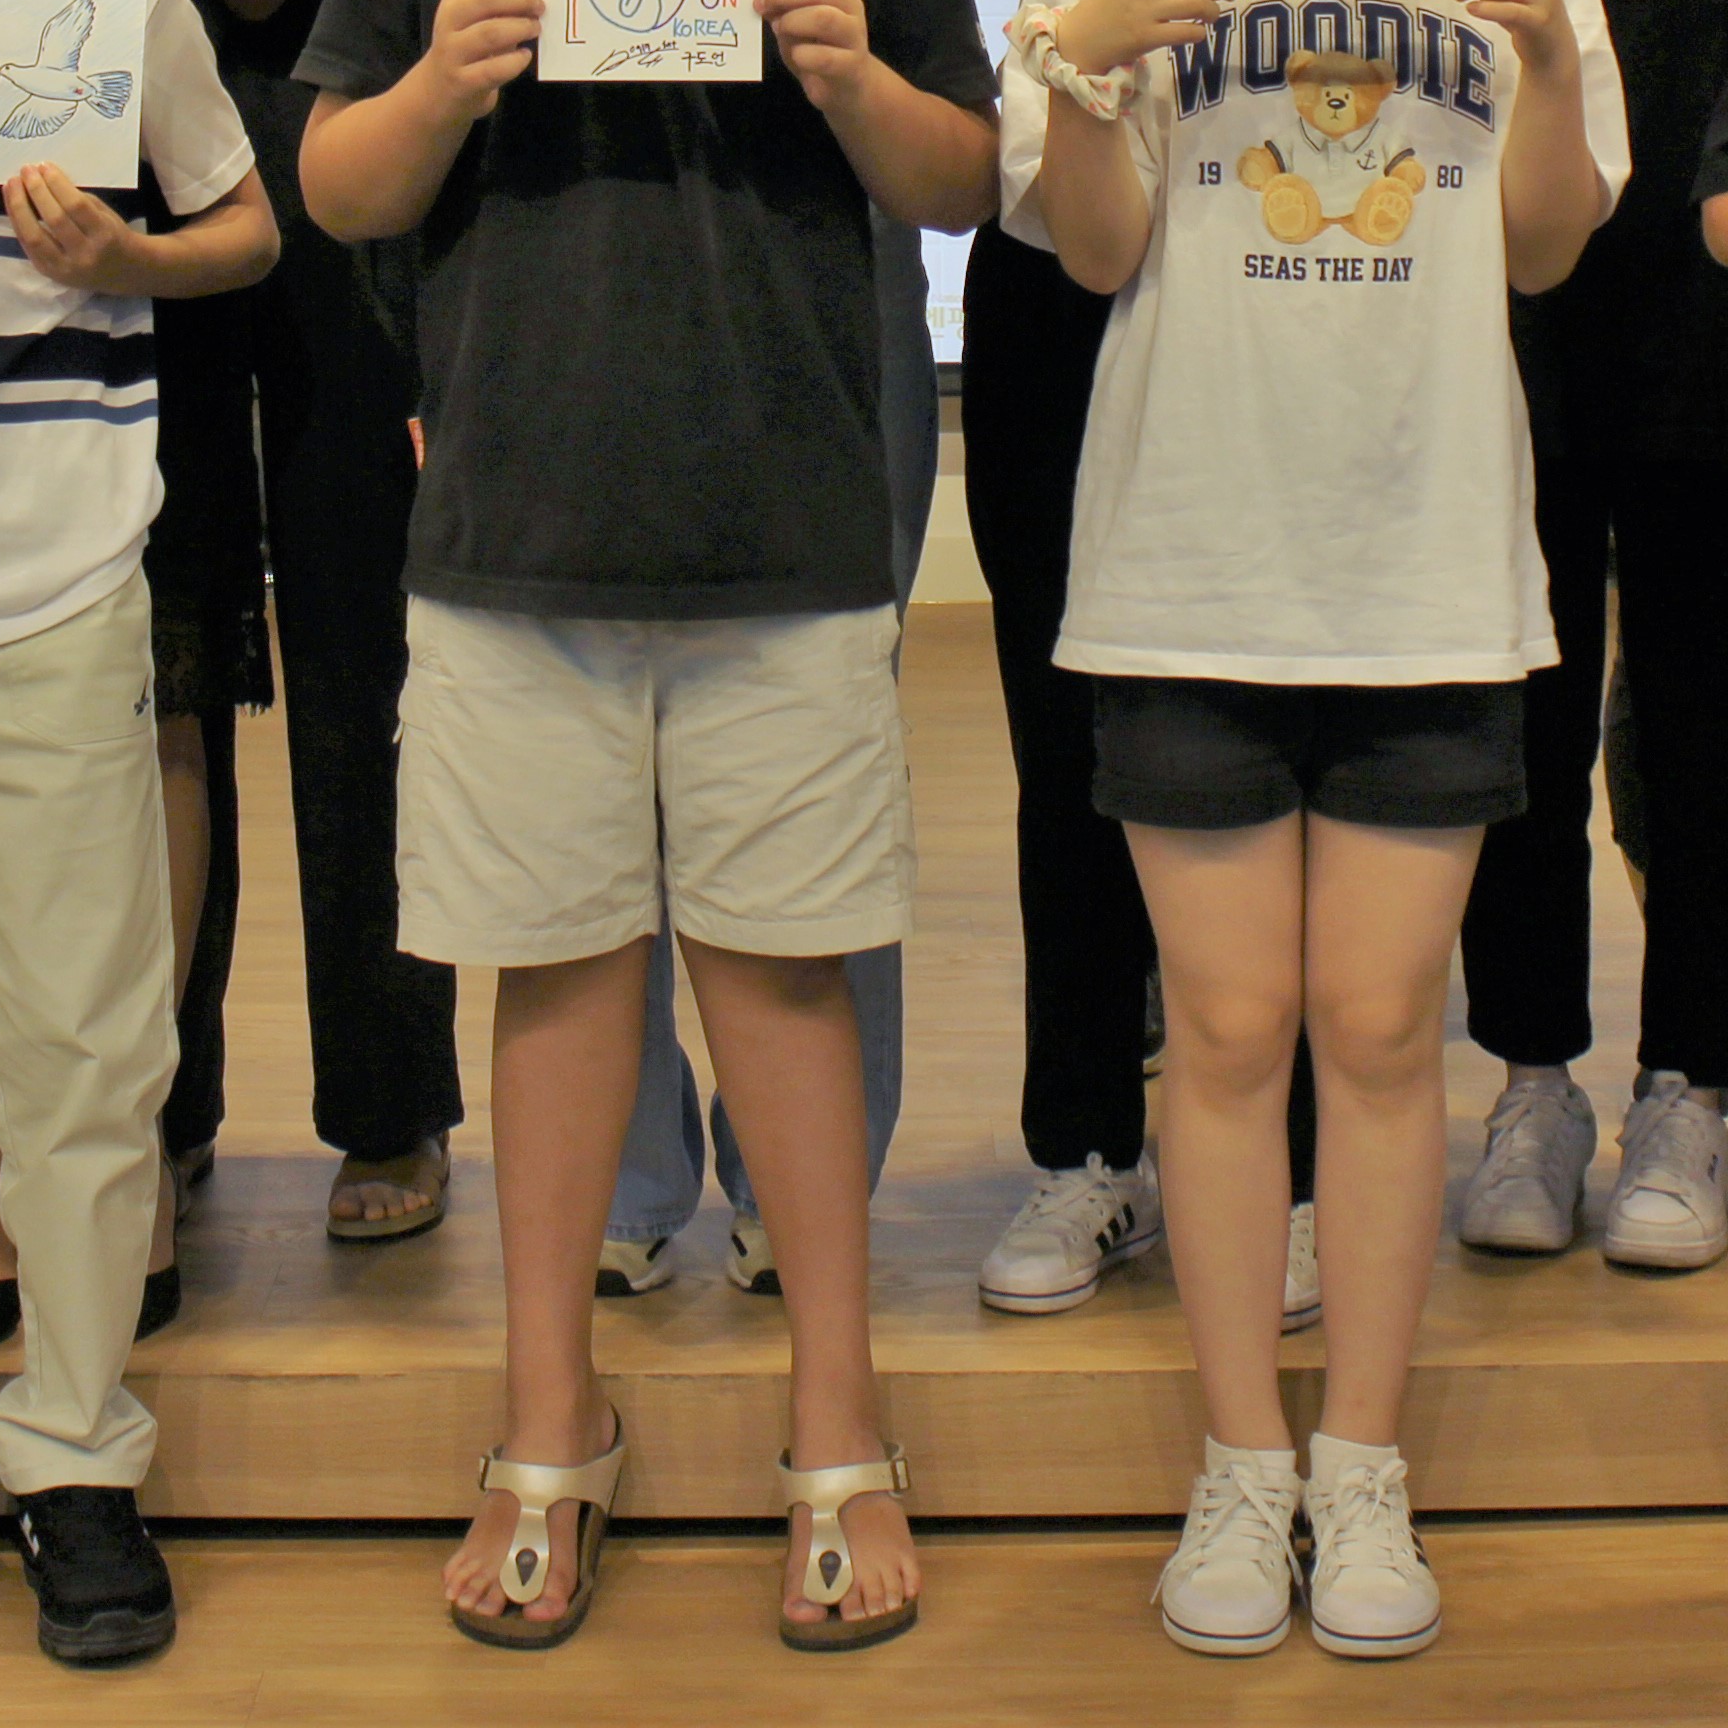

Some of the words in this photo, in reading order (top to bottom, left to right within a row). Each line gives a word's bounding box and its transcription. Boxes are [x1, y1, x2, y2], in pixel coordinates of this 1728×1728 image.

[1198, 161, 1222, 186] 19
[1437, 165, 1463, 189] 80
[1244, 254, 1307, 282] SEAS
[1315, 256, 1365, 282] THE
[1372, 256, 1414, 282] DAY
